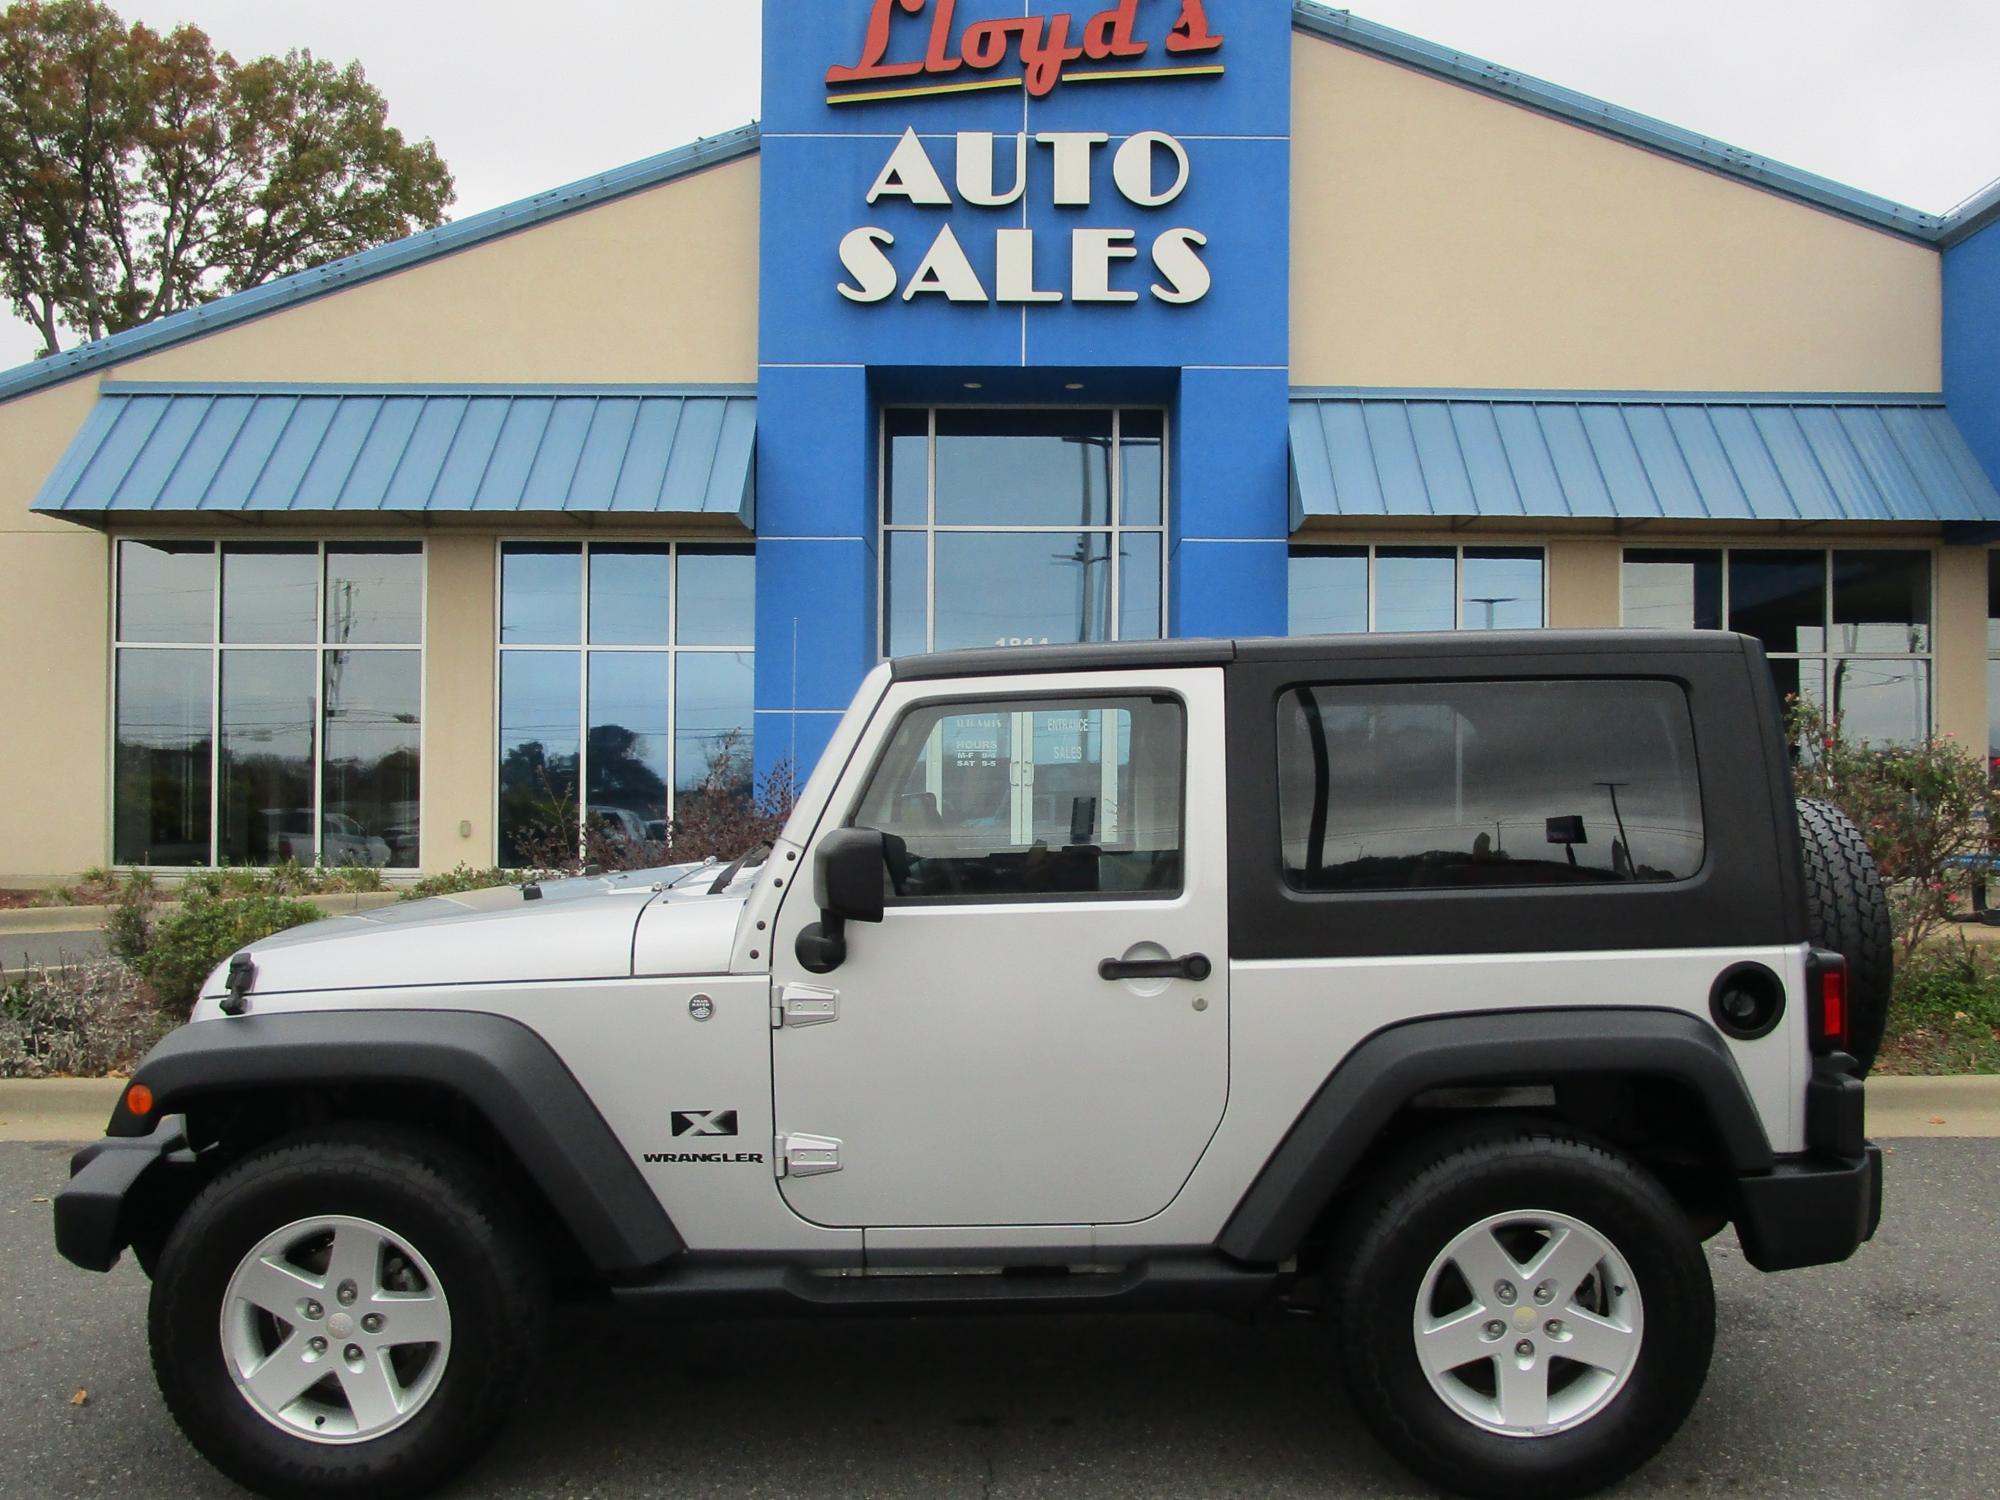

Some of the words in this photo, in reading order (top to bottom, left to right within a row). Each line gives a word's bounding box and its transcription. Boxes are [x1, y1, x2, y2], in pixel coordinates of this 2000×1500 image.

[825, 0, 1224, 97] Lloyds
[866, 125, 1190, 206] AUTO
[837, 222, 1211, 304] SALES
[1047, 718, 1089, 732] ENTRANCE
[956, 740, 998, 749] HOURS
[1053, 746, 1083, 760] SALES
[643, 1152, 764, 1163] WRANGLER
